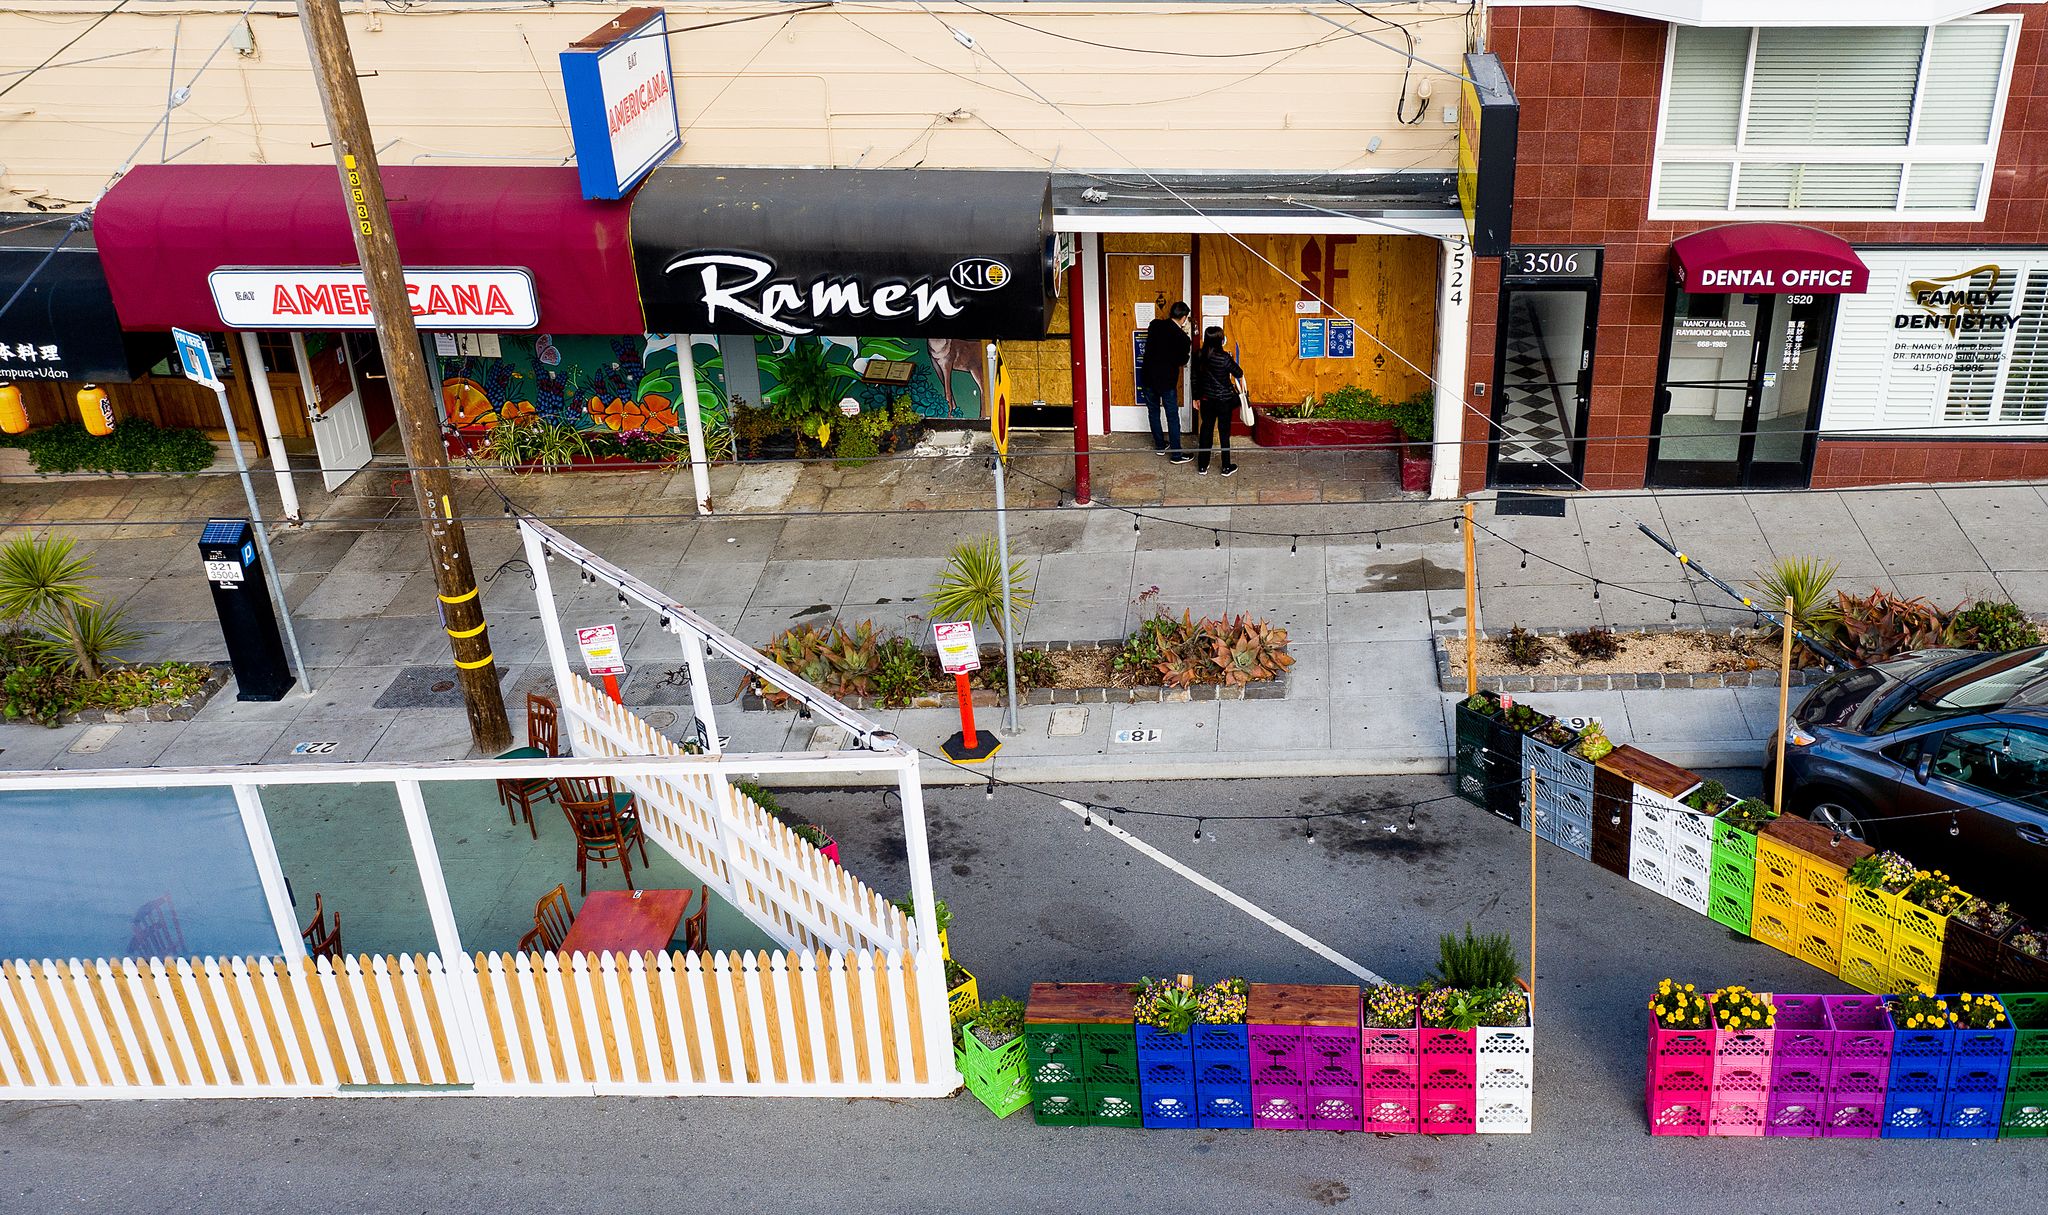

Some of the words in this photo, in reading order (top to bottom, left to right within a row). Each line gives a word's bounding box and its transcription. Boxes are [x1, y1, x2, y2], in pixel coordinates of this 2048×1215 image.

[627, 51, 638, 70] EAT
[609, 70, 669, 137] AMERICANA
[350, 173, 371, 234] 3532
[1450, 234, 1465, 306] 3524
[1523, 253, 1579, 273] 3506
[1702, 269, 1775, 286] DENTAL
[1781, 269, 1853, 286] OFFICE
[235, 291, 255, 301] EAT
[272, 284, 513, 316] AMERCANA
[665, 254, 965, 335] Ramen
[1787, 295, 1814, 305] 3520
[1916, 290, 2001, 306] FAMILY
[1894, 314, 2022, 329] DENTISTRY
[1893, 352, 1907, 360] DR.
[1910, 352, 1954, 360] RAYMOND
[1912, 364, 1985, 372] 415-668-1985
[209, 563, 232, 571] 321
[1131, 730, 1157, 741] 18
[305, 742, 338, 753] 22
